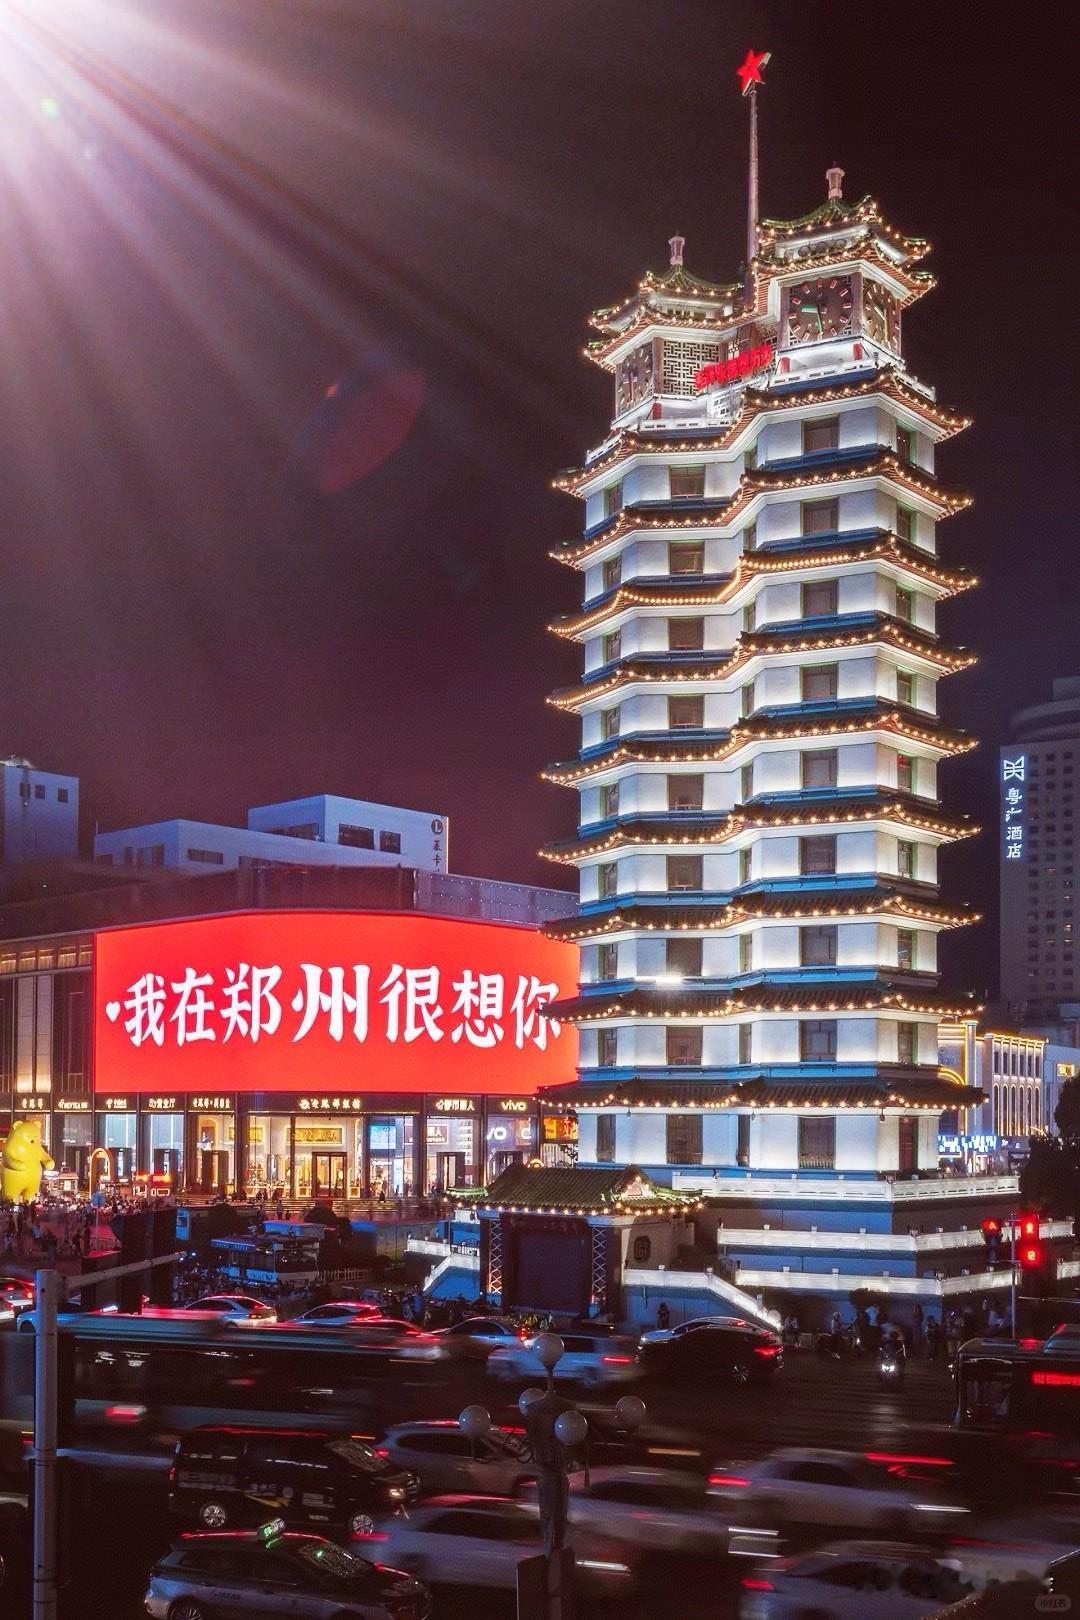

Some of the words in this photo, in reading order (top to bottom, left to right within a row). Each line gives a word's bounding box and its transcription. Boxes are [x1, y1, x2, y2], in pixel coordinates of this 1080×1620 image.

[432, 840, 443, 872] 莱卡
[124, 963, 561, 1049] 我在郑州很想你
[500, 1100, 527, 1111] vivo
